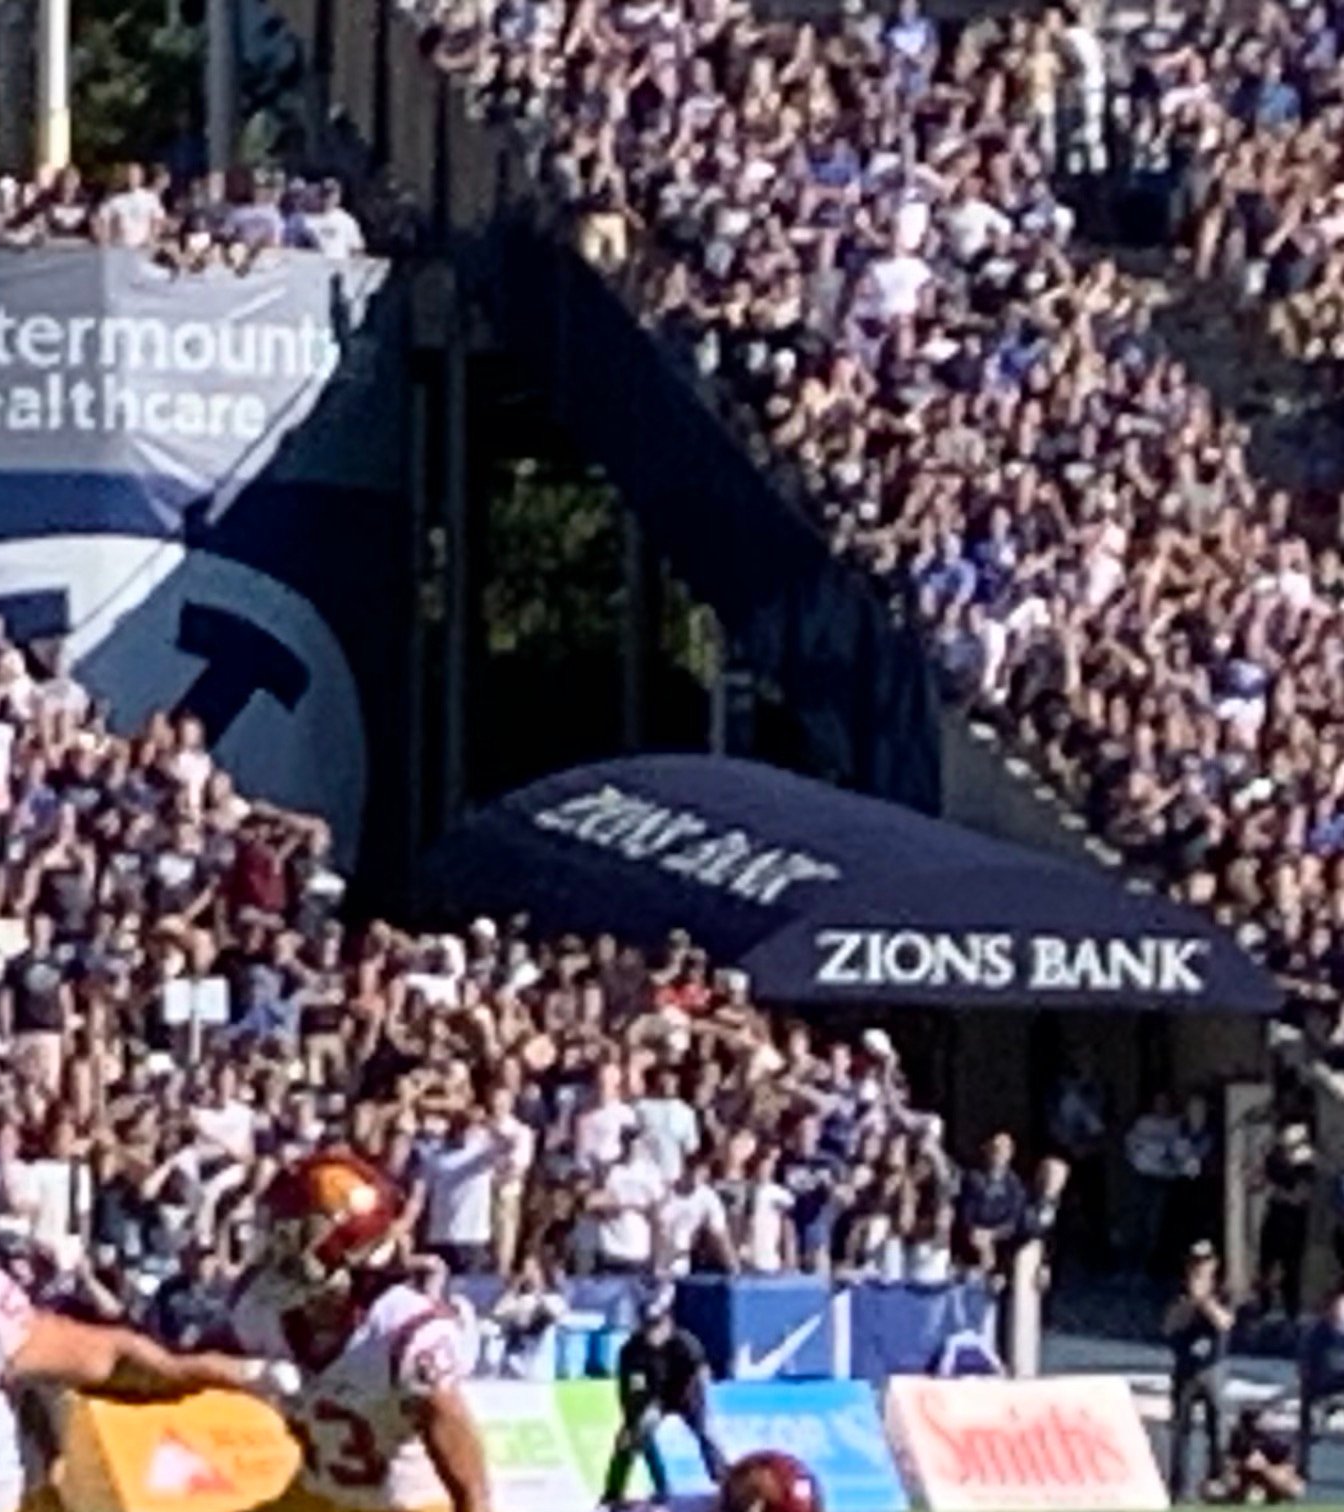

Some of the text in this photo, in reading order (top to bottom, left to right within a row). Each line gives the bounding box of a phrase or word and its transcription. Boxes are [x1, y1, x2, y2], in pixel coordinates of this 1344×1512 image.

[814, 930, 1208, 993] ZIONS BANK
[287, 1397, 390, 1488] 3
[914, 1388, 1131, 1487] Smith's
